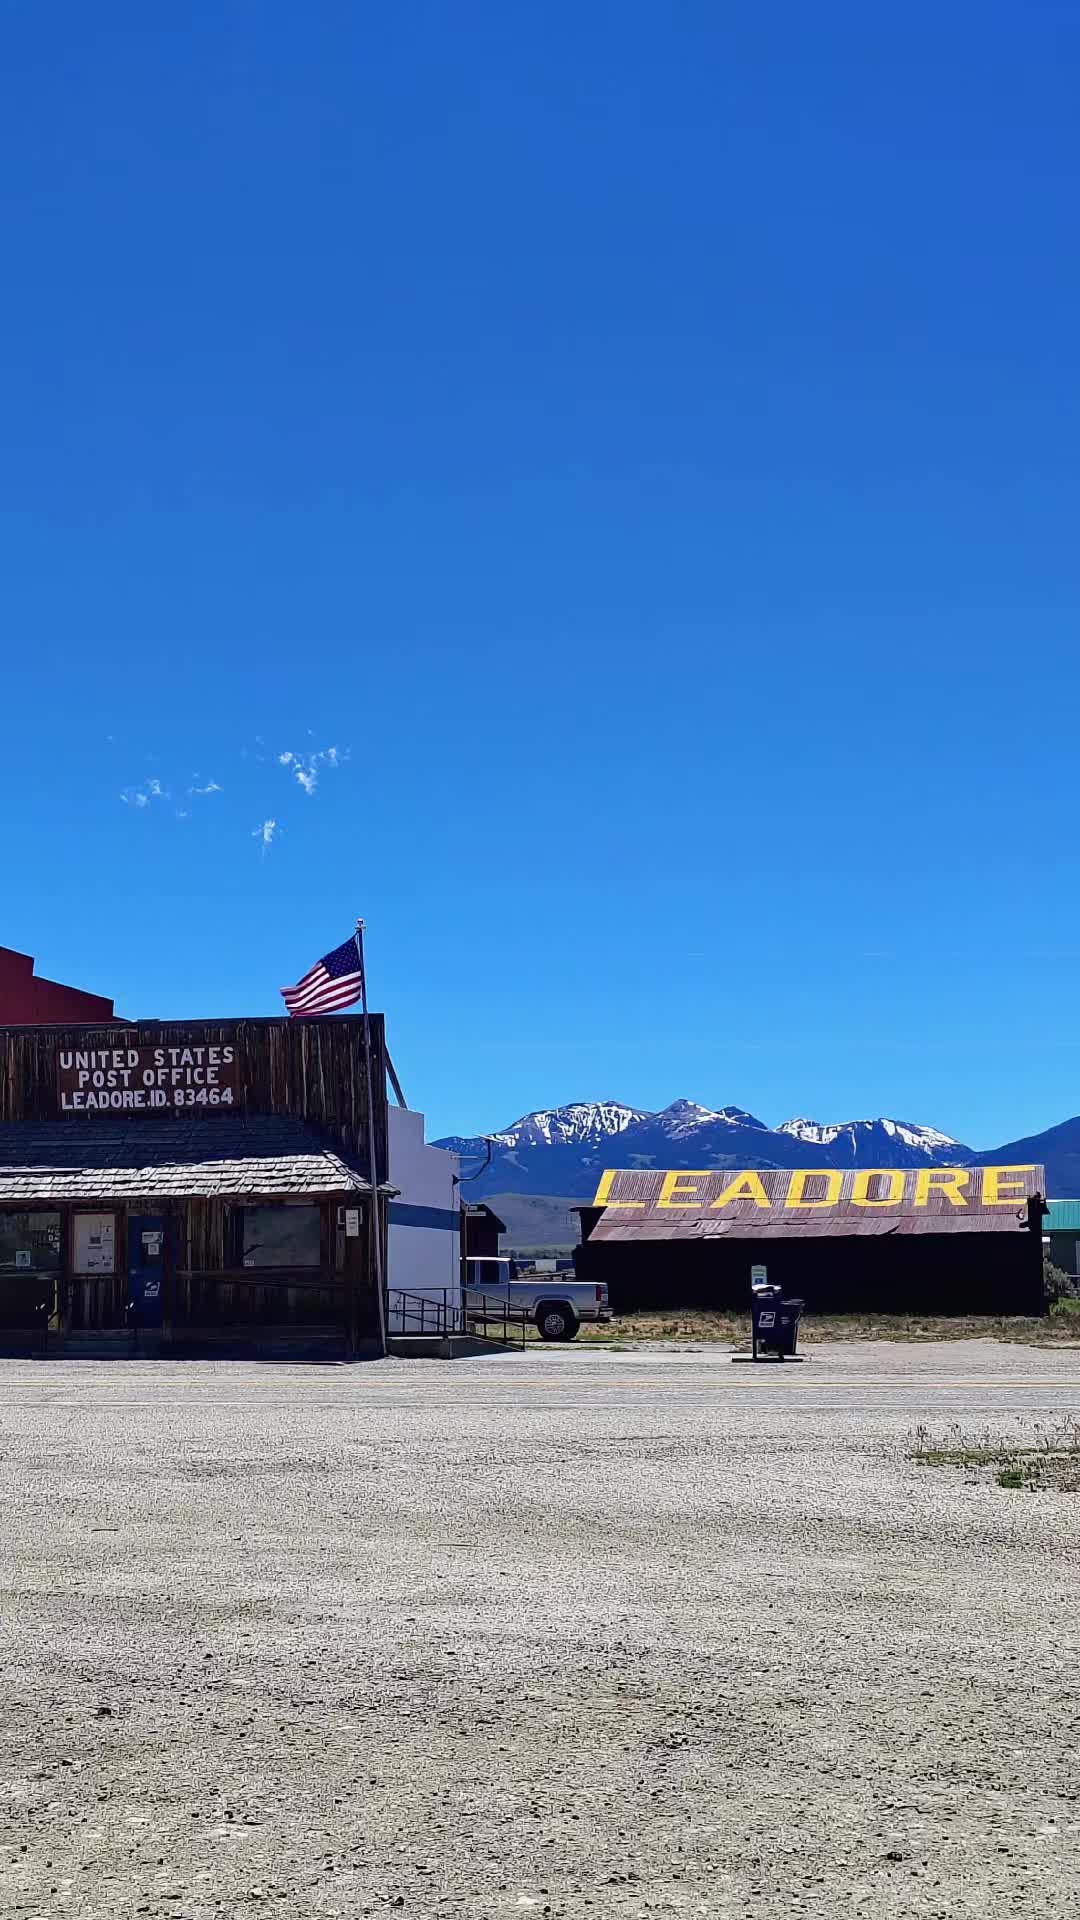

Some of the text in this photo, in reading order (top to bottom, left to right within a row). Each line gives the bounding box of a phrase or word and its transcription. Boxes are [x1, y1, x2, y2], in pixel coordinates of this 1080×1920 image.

[59, 1047, 234, 1069] UNITED STATES
[78, 1067, 219, 1088] POST OFFICE
[174, 1087, 234, 1106] 83464
[592, 1165, 1036, 1208] LEADORE
